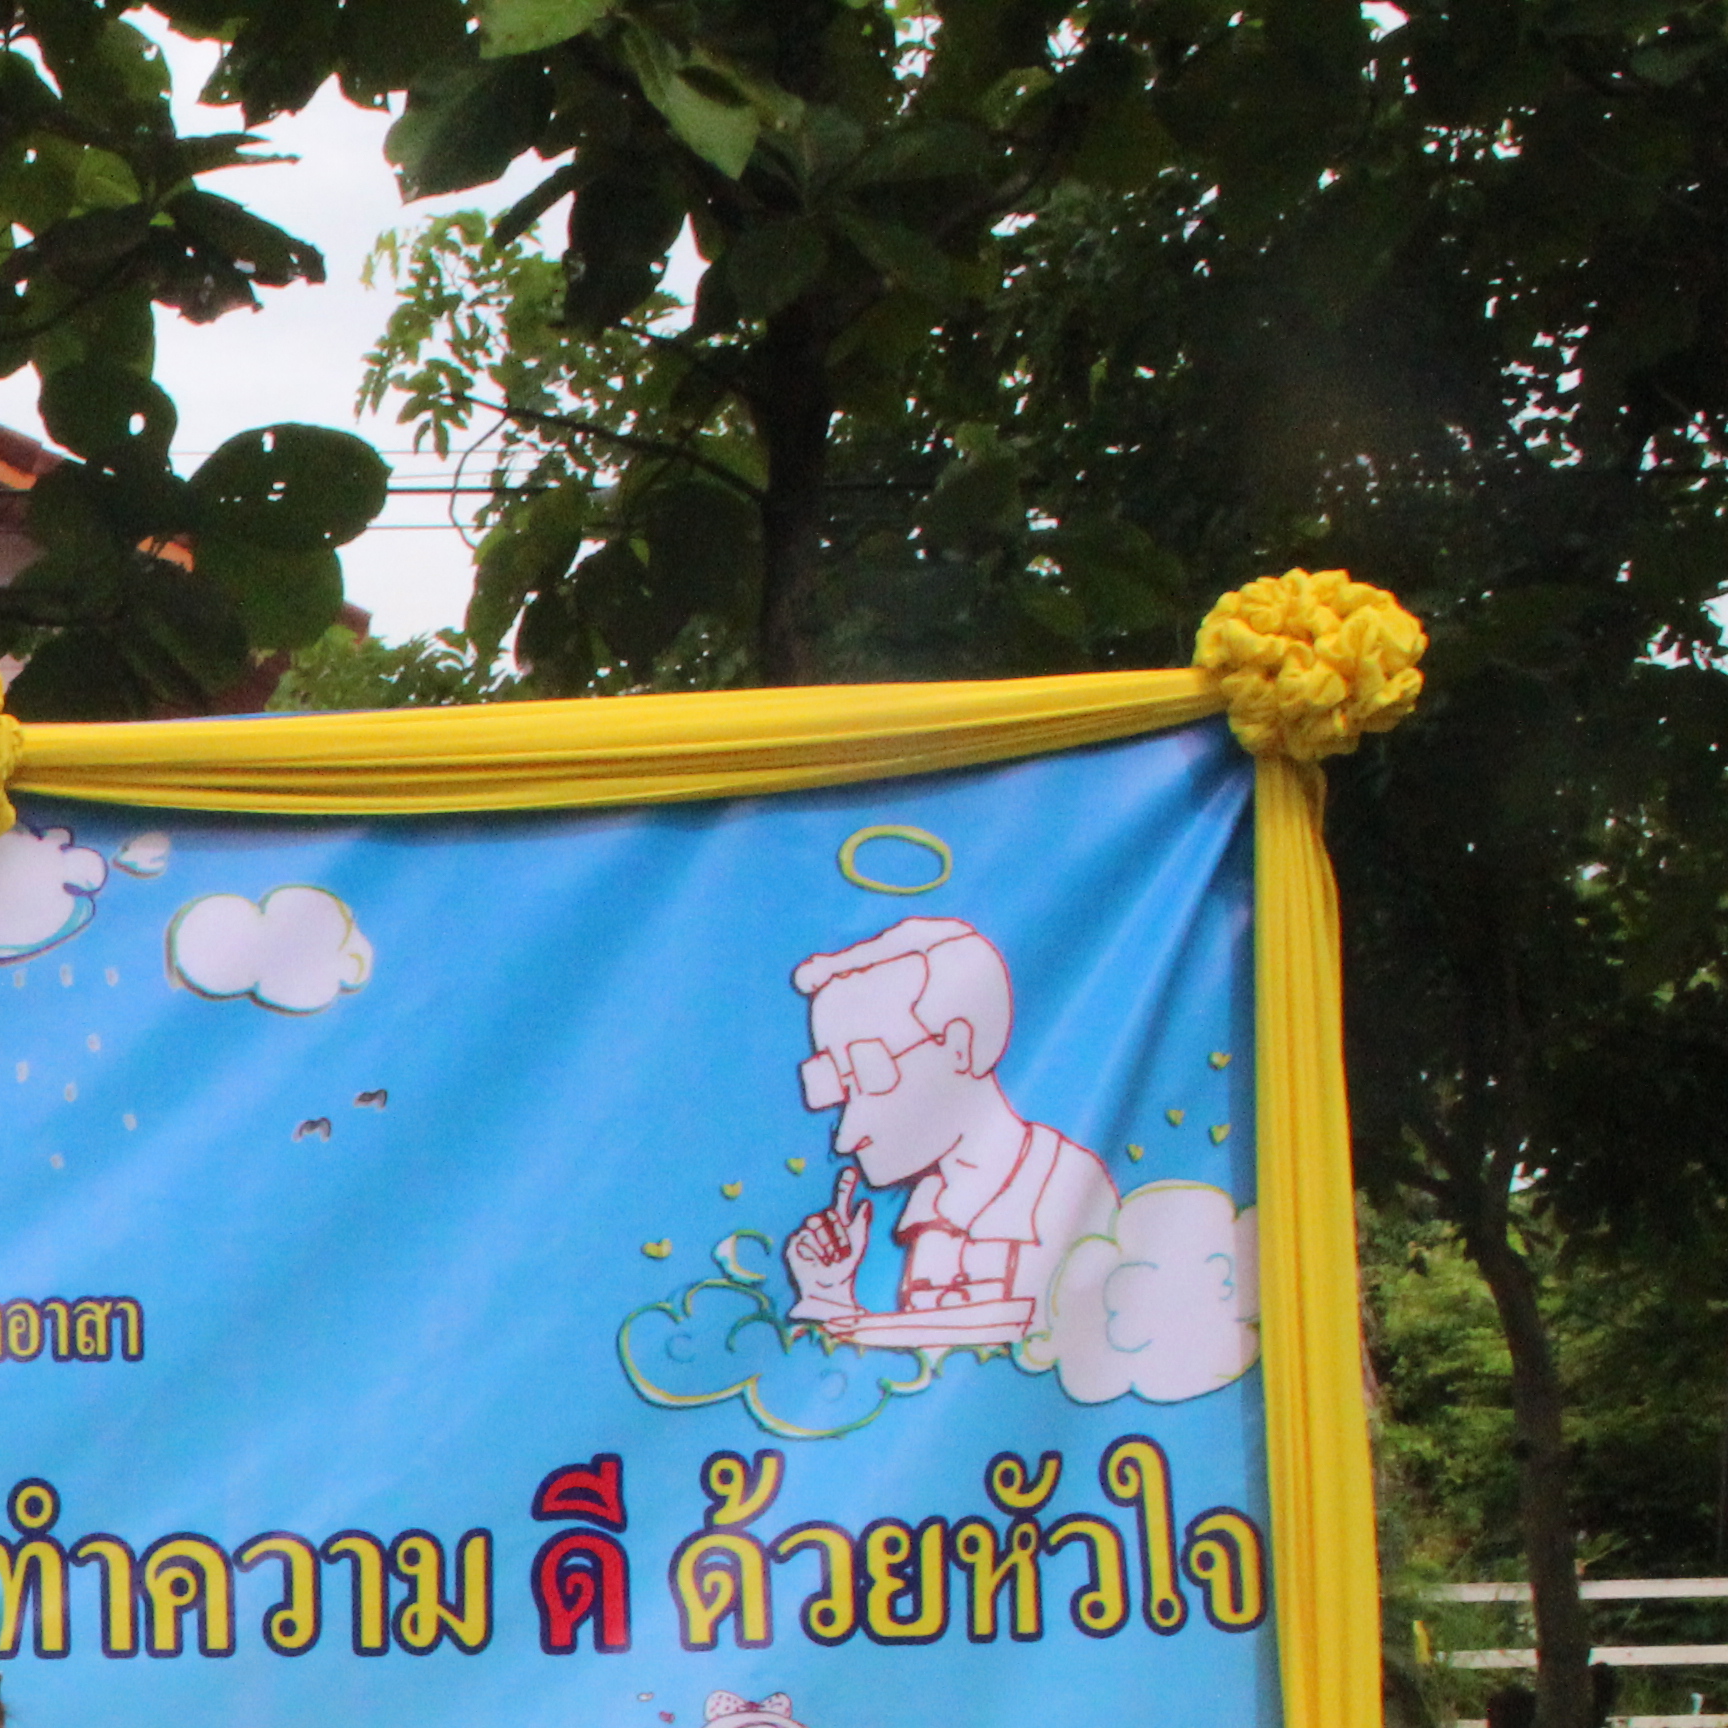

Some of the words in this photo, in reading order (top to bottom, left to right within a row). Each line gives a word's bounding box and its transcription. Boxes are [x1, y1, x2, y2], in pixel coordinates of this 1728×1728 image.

[530, 1451, 630, 1656] ดี
[669, 1435, 1266, 1654] ด้วยหัวใจ
